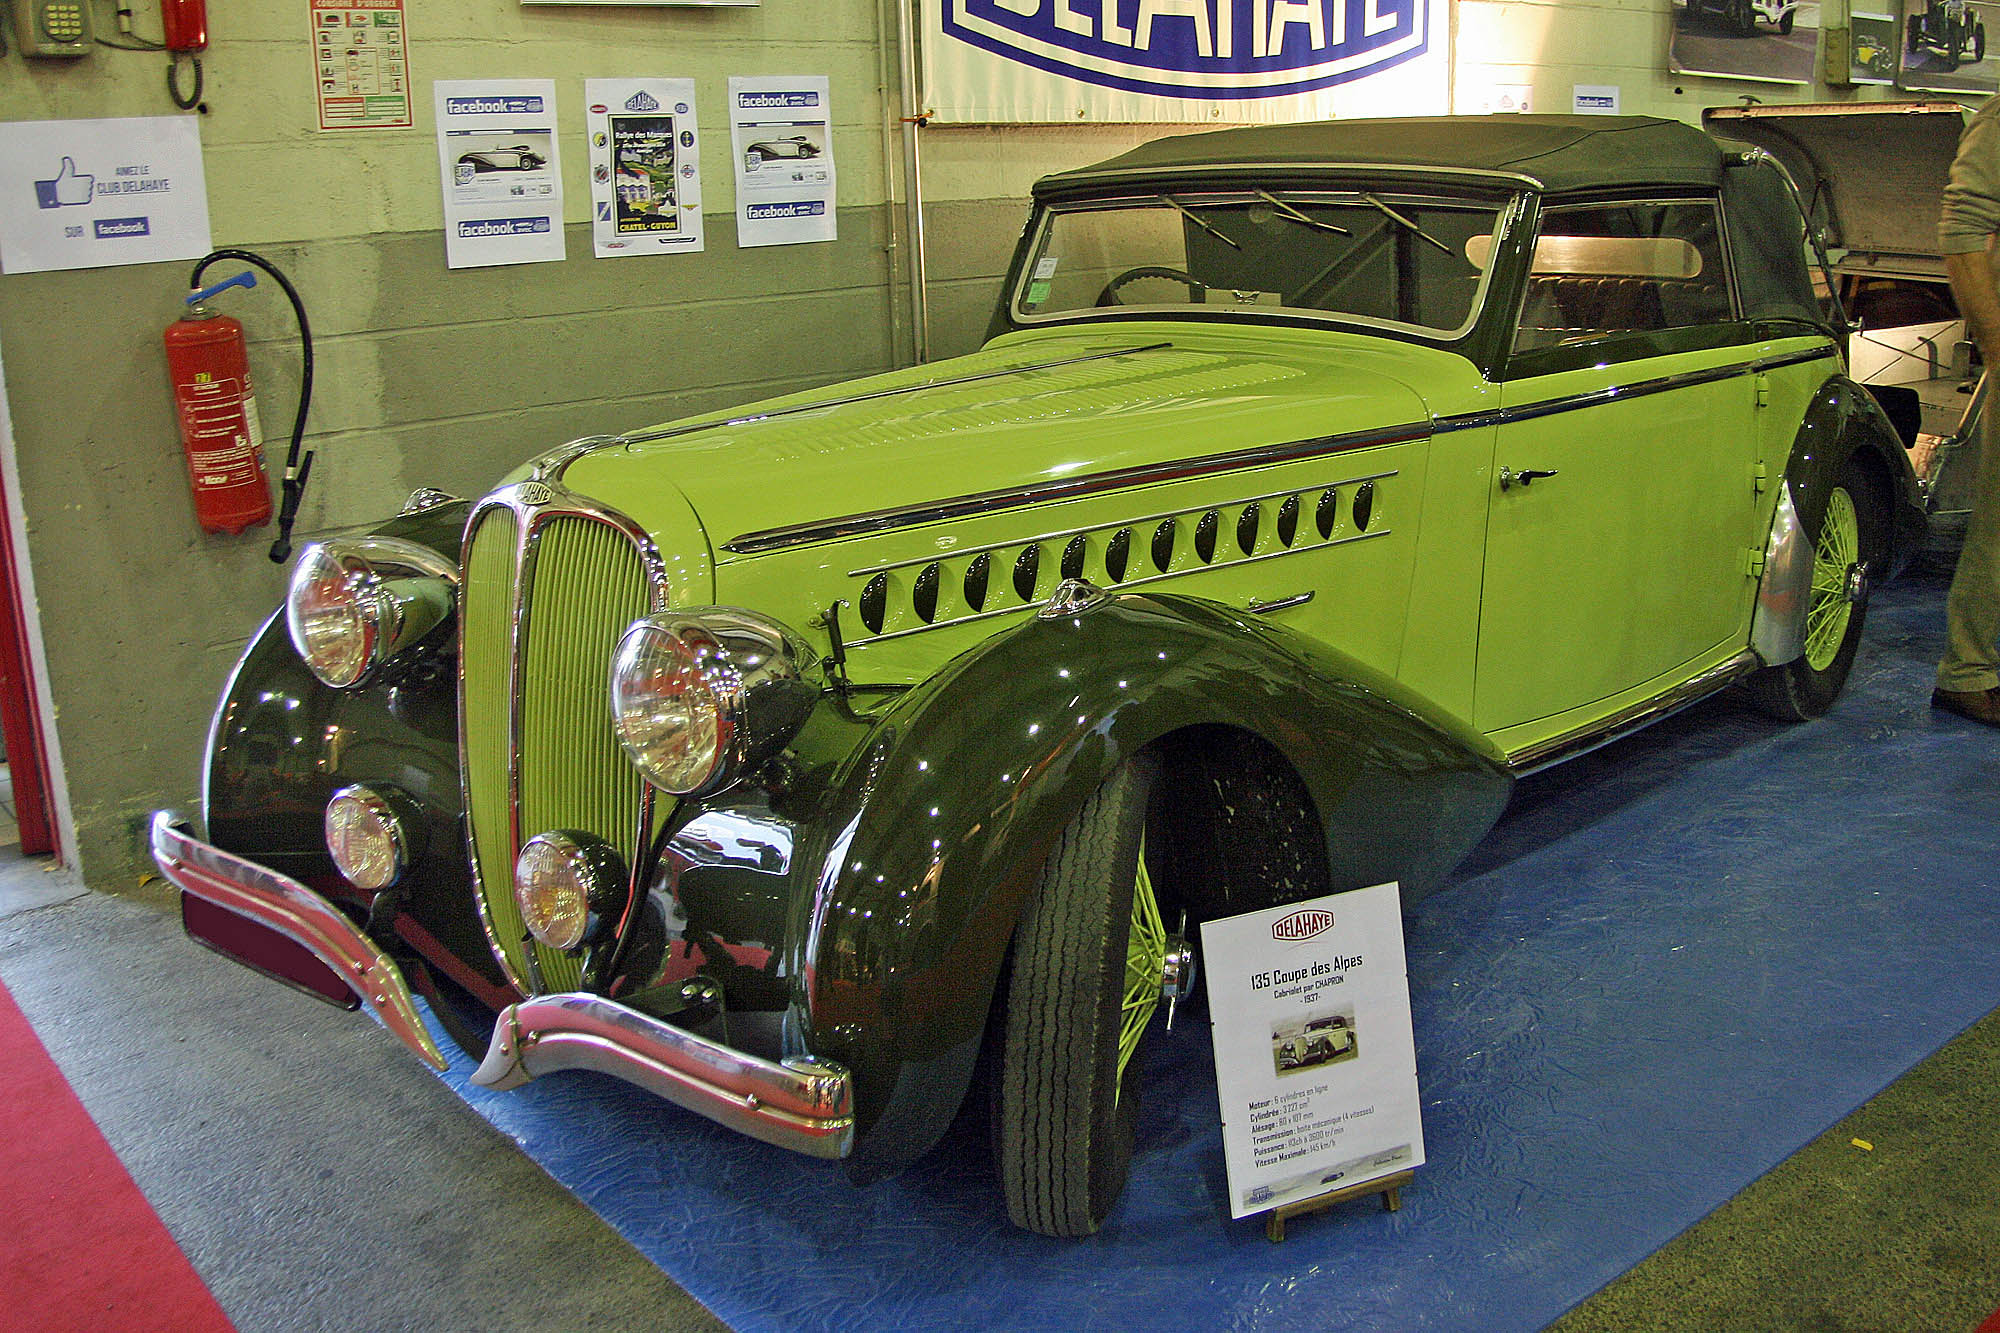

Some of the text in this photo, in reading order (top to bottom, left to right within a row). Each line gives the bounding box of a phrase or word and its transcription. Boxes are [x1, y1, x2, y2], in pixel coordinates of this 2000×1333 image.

[448, 99, 508, 113] facebook
[739, 94, 788, 107] facebook
[141, 165, 150, 175] LE
[97, 178, 170, 194] CLUB DELAHAYE
[747, 204, 796, 218] facebook
[65, 222, 146, 238] SUR facebook
[460, 221, 514, 236] facebook
[1276, 913, 1331, 937] DELAHAYE
[1251, 955, 1363, 990] 135 Coupe des Alpes
[1274, 975, 1344, 999] Cabriolet par CHAPRON
[1274, 1096, 1279, 1104] 6
[1255, 1157, 1278, 1169] Vitesse
